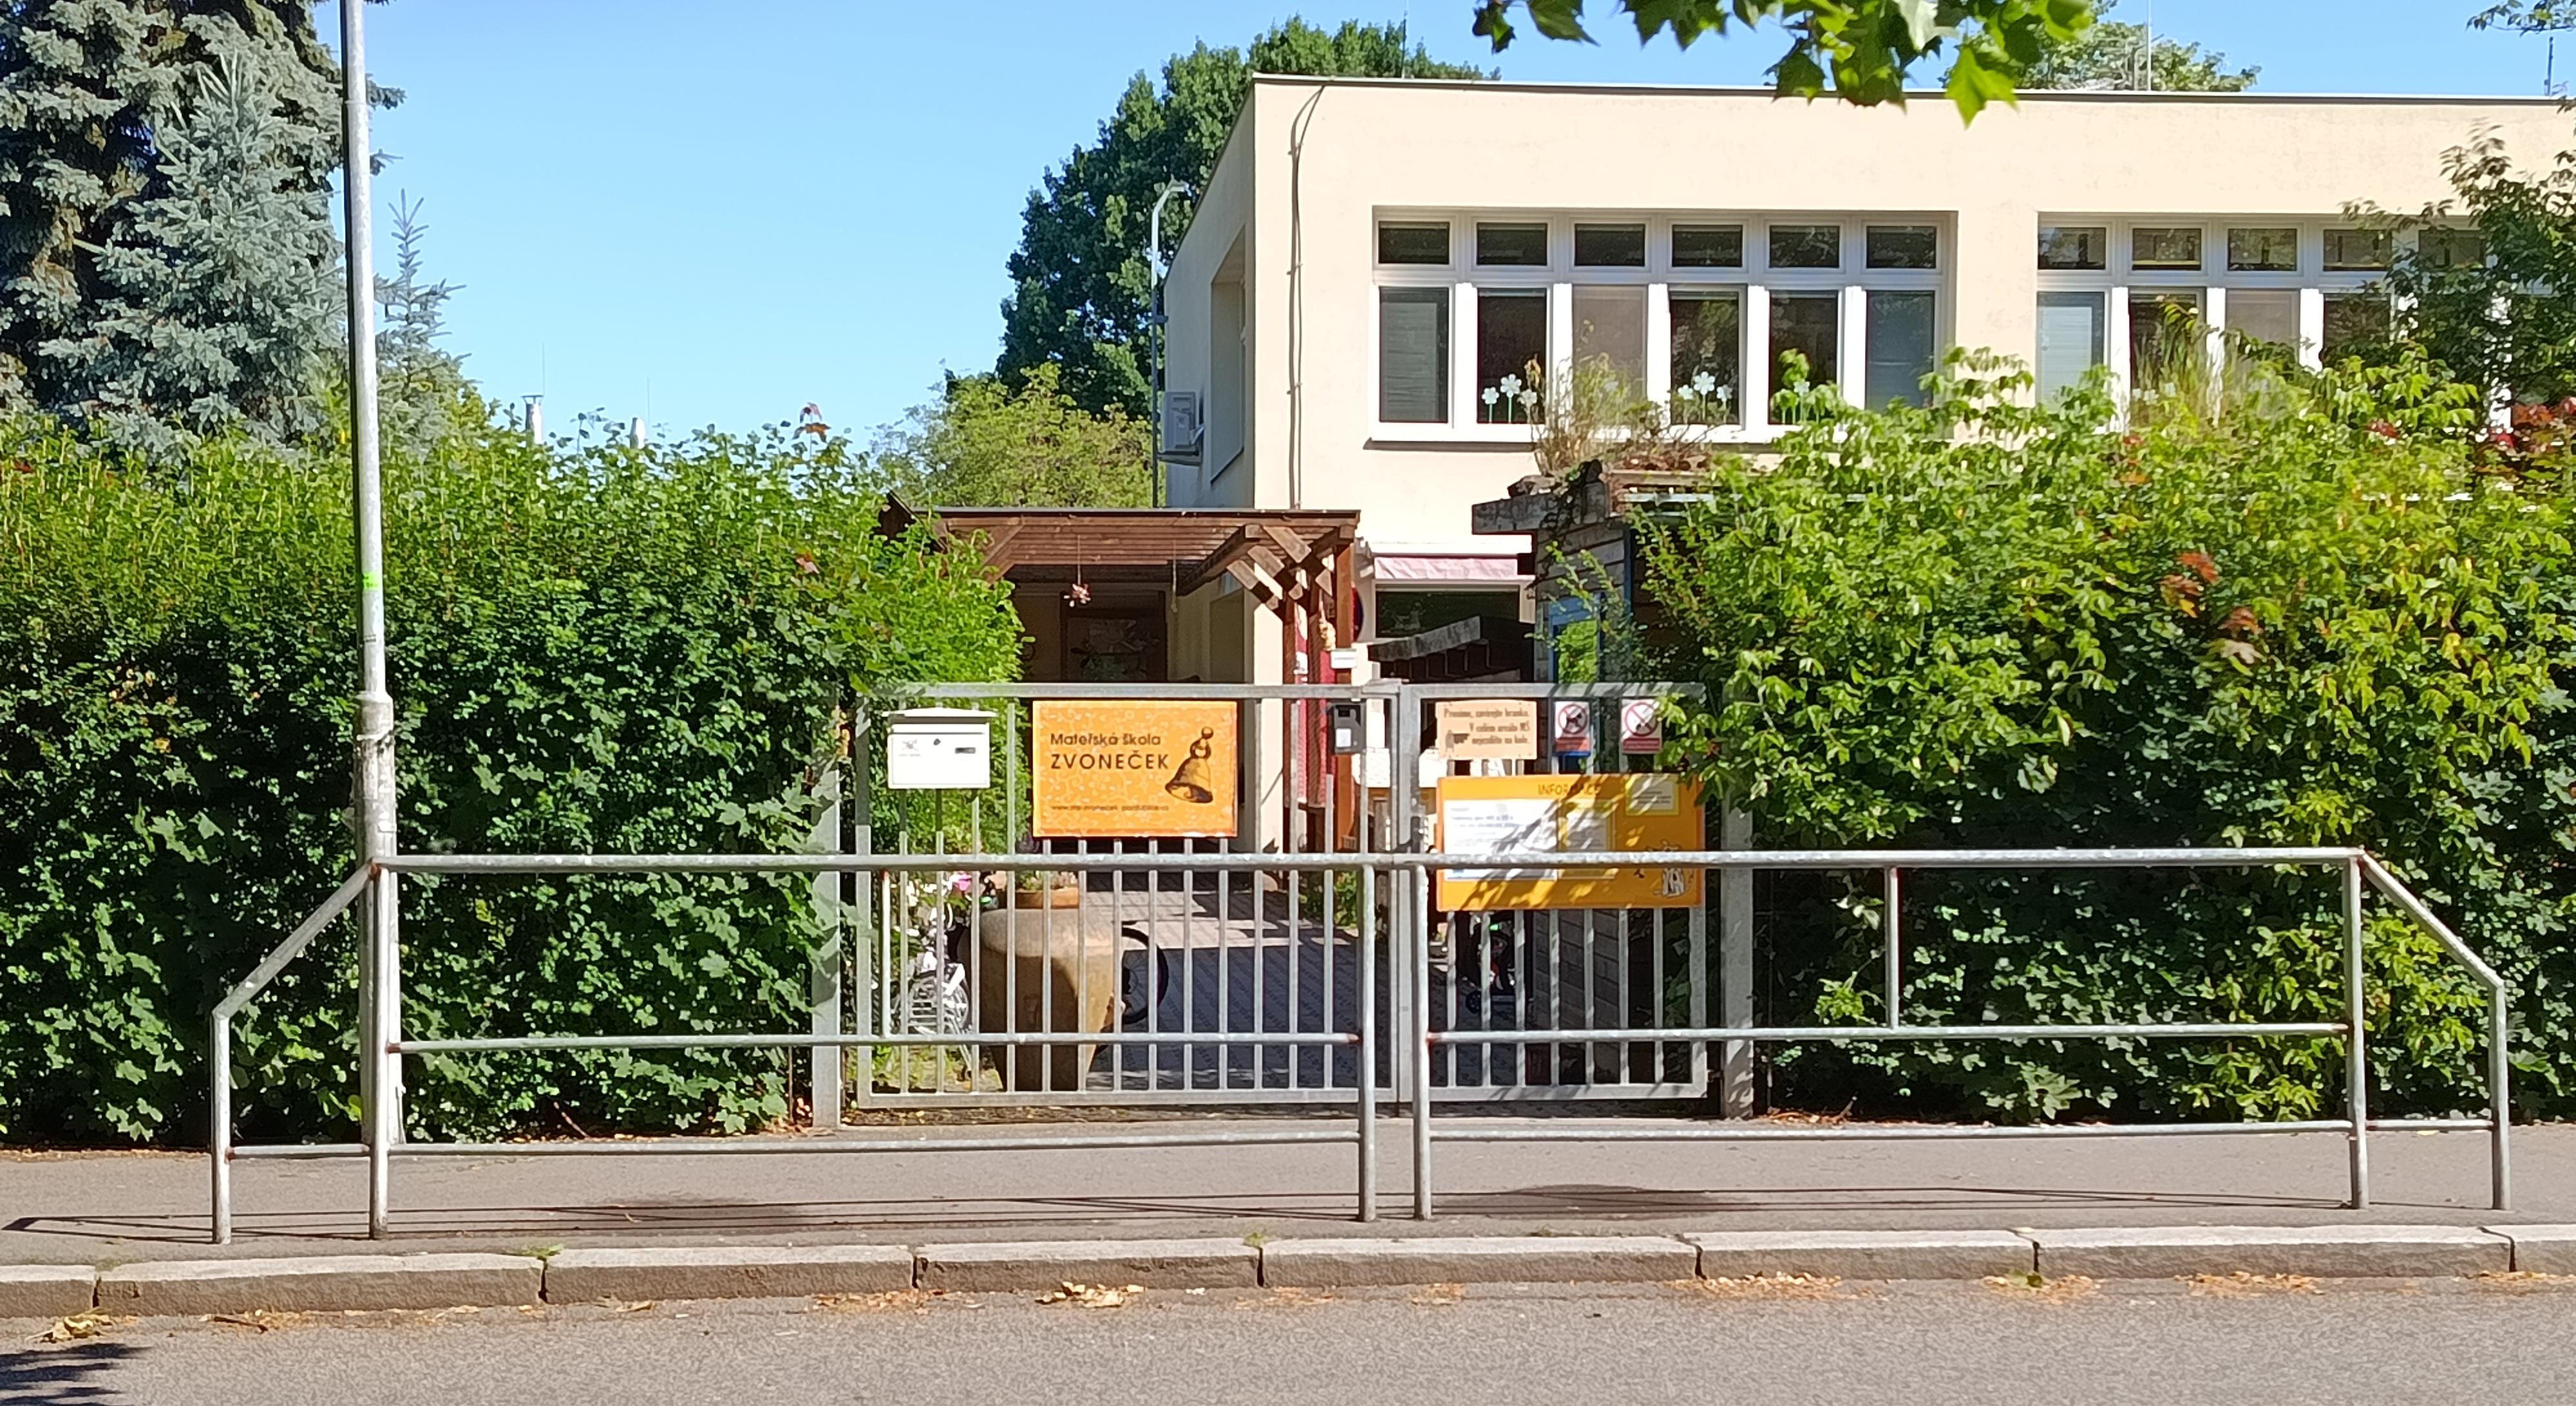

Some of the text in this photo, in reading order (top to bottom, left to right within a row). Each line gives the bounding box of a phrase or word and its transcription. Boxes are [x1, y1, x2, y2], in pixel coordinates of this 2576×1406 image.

[1050, 733, 1160, 745] Mateřská škola
[1050, 749, 1169, 769] ZVONEČEK
[1537, 783, 1602, 795] INFORCE
